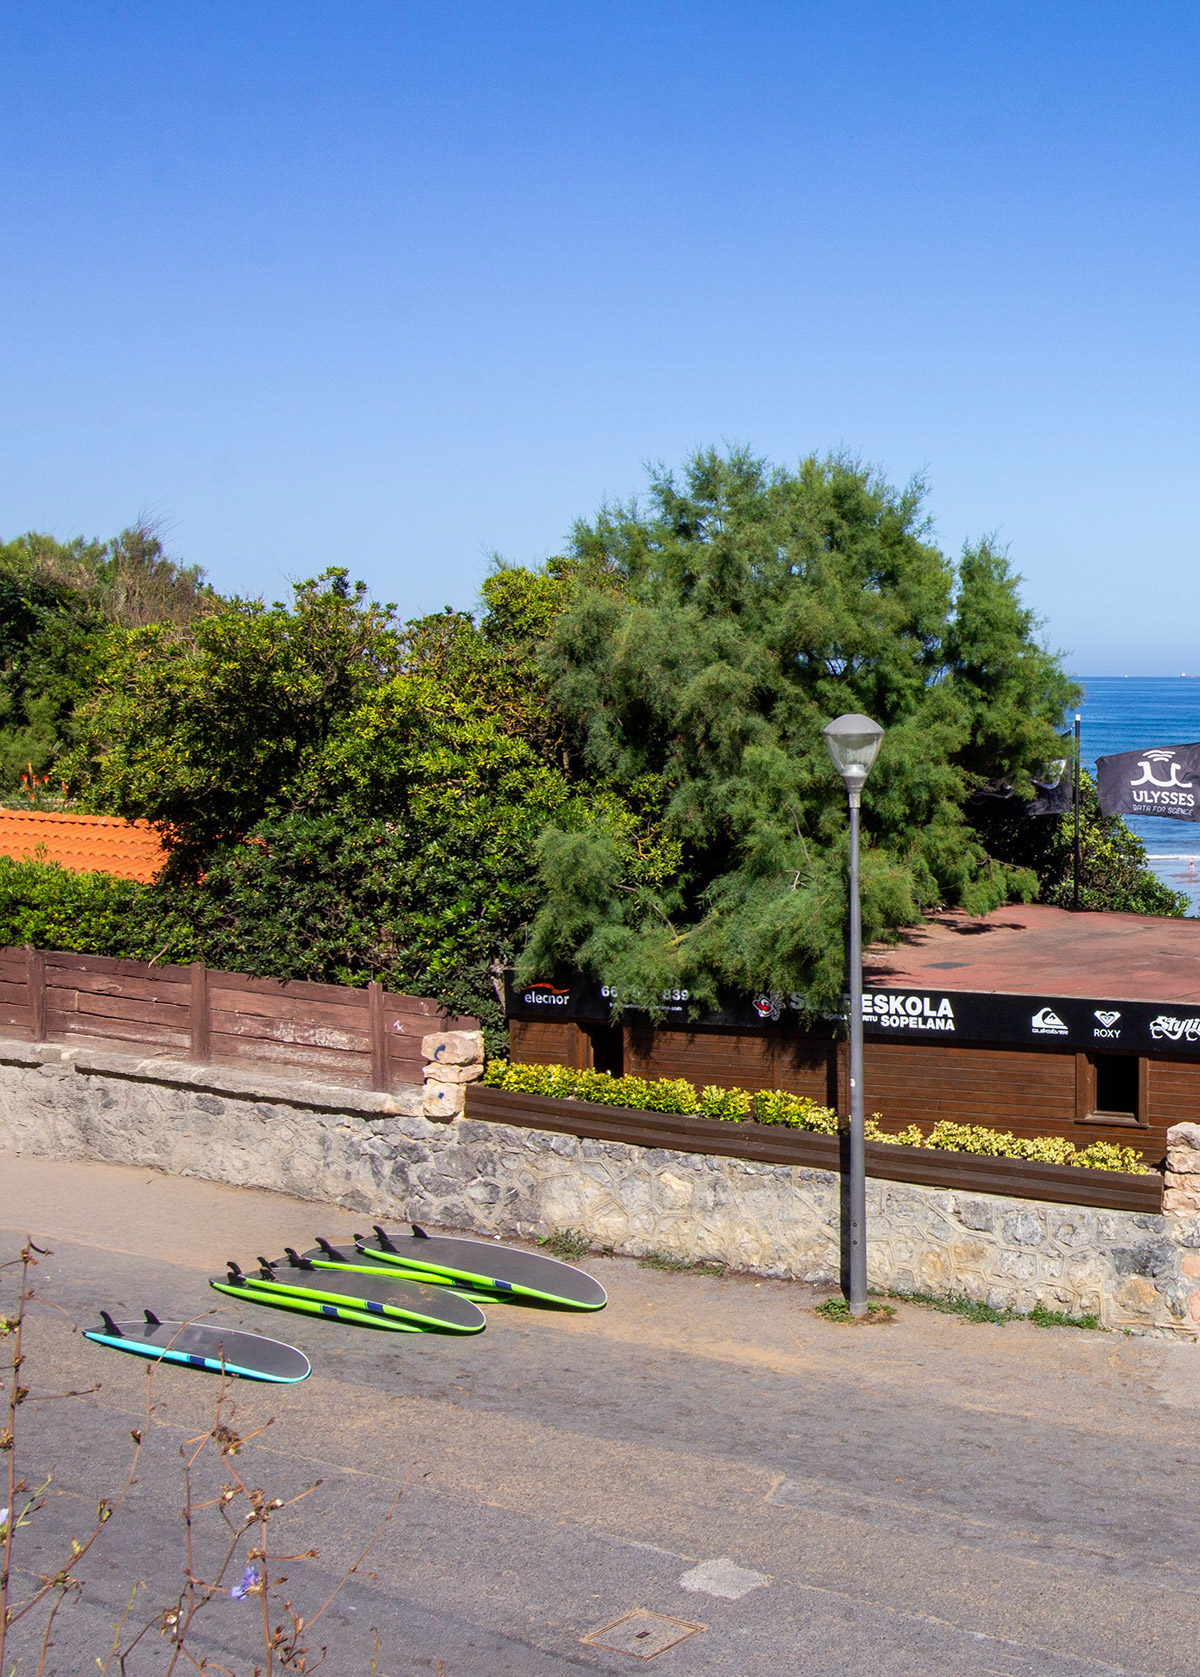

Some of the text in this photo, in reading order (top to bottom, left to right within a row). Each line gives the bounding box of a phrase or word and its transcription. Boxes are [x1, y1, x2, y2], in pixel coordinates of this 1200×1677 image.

[1132, 790, 1195, 807] ULYSSES
[1168, 807, 1194, 816] SCIENCE
[524, 992, 569, 1005] elecnor
[663, 989, 688, 1001] 839
[861, 994, 954, 1017] ESKOLA
[881, 1017, 955, 1031] SOPELANA
[1094, 1029, 1121, 1038] ROXY
